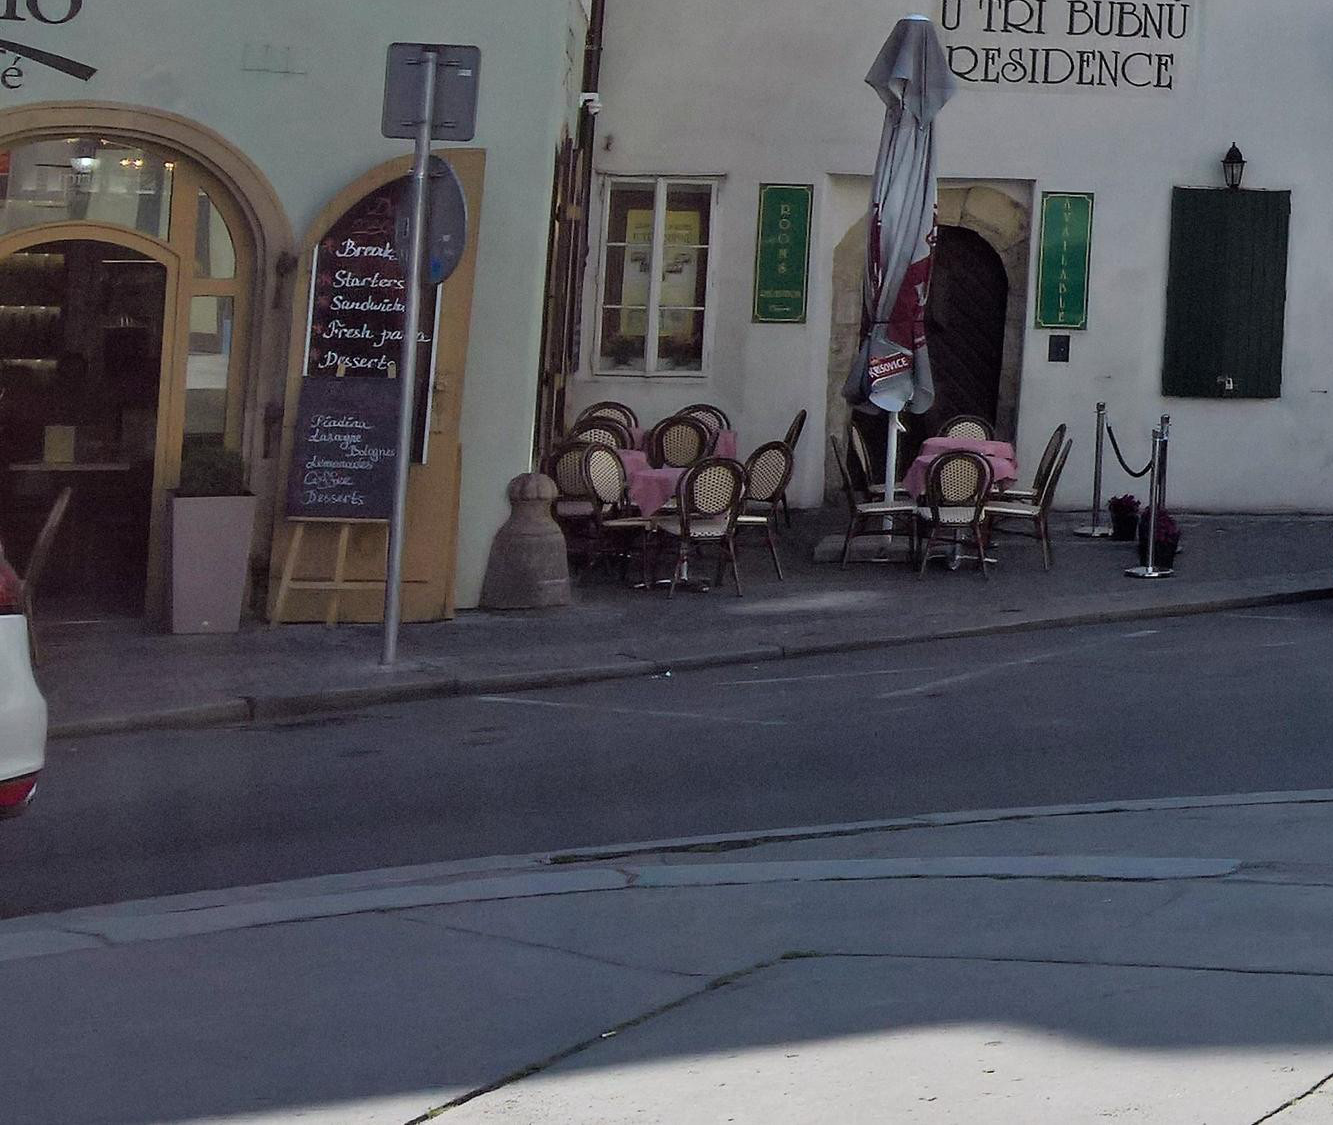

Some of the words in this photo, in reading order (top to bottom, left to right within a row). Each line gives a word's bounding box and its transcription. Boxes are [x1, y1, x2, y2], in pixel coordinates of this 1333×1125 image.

[946, 45, 1174, 90] RESIDENCE
[333, 270, 405, 290] Starters
[323, 320, 374, 340] Fresh
[373, 328, 431, 348] paa
